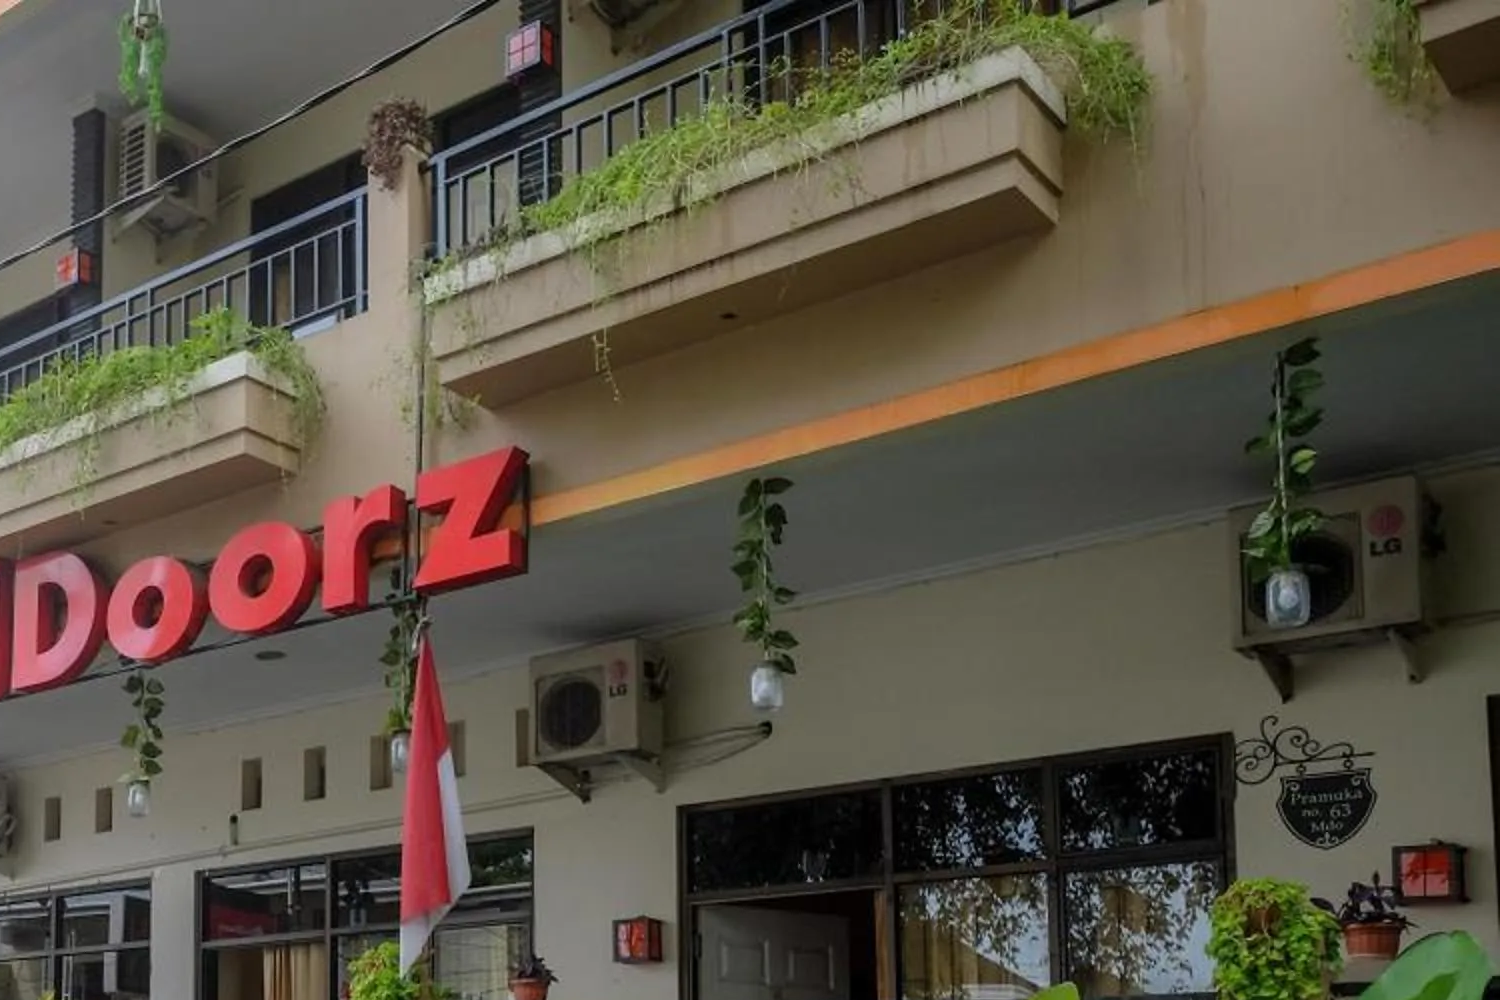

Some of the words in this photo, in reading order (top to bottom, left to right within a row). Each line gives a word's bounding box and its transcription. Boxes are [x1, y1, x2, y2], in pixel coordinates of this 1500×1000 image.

[1370, 537, 1402, 557] LG
[608, 683, 628, 698] LG
[1290, 787, 1364, 806] Pramuka
[1329, 802, 1352, 819] 63
